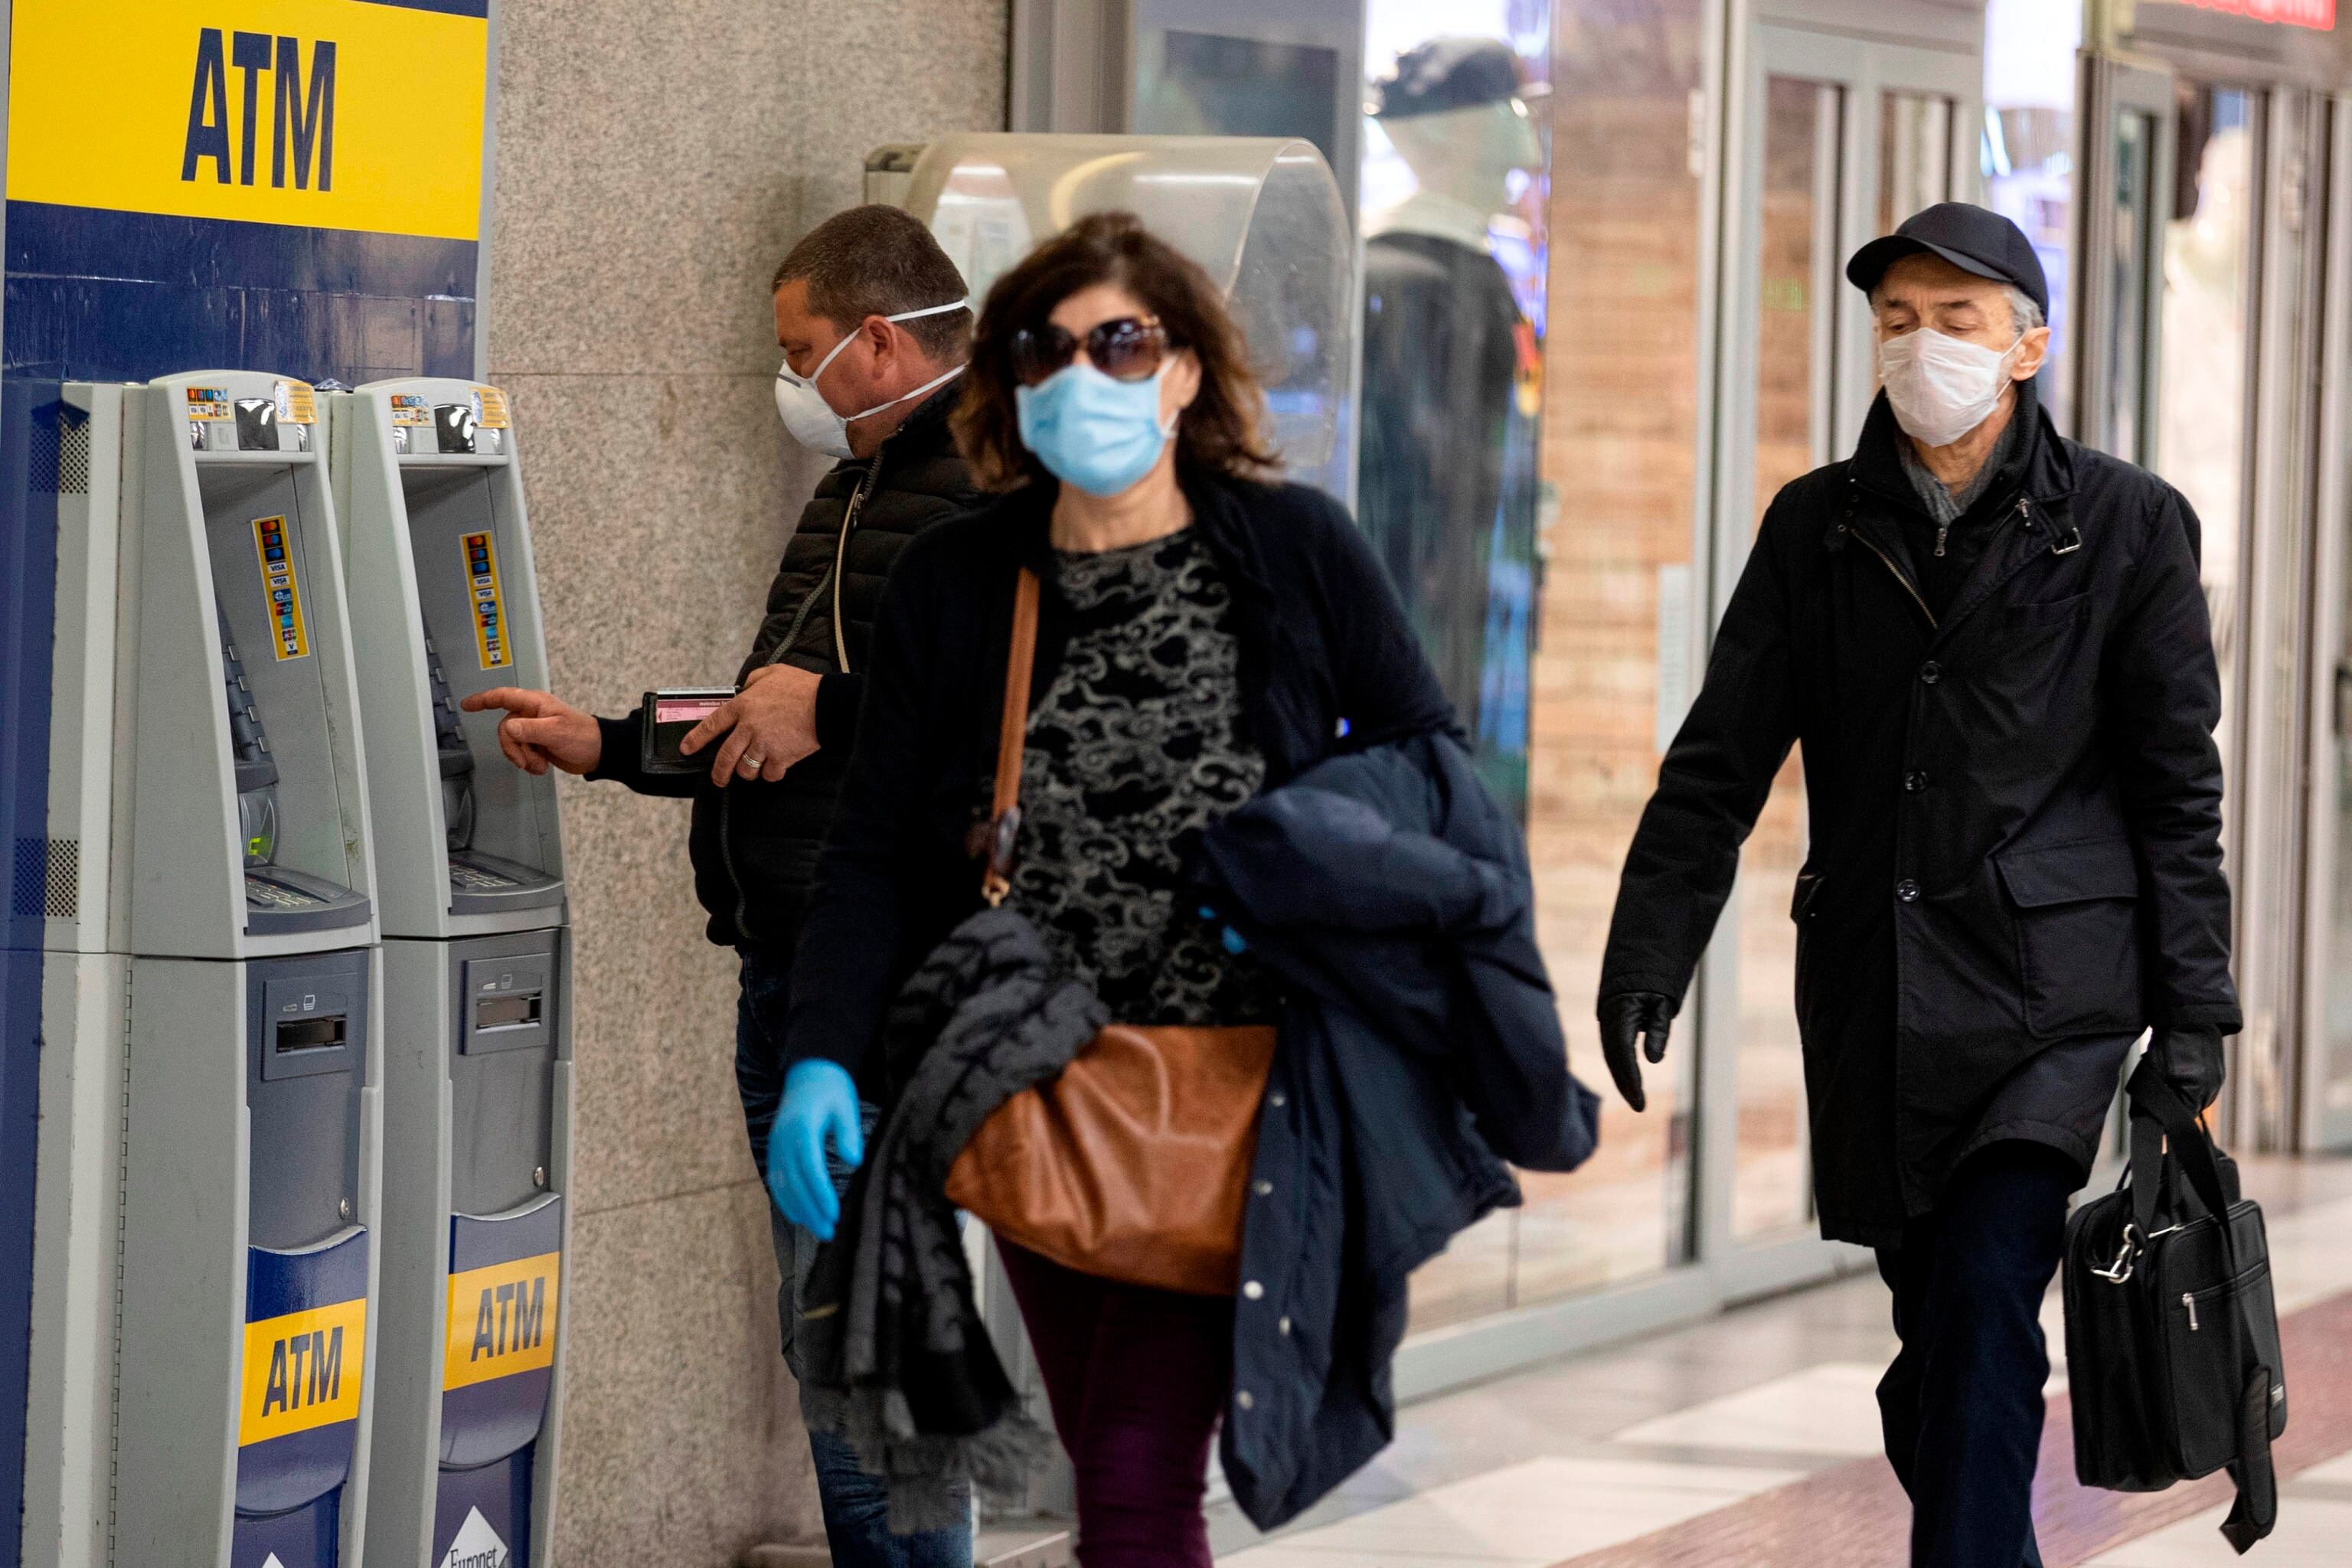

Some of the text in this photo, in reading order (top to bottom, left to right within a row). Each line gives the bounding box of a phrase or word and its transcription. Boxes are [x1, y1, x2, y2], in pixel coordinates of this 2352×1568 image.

[181, 27, 336, 191] ATM
[470, 1276, 544, 1362] ATM
[261, 1325, 343, 1417] ATM
